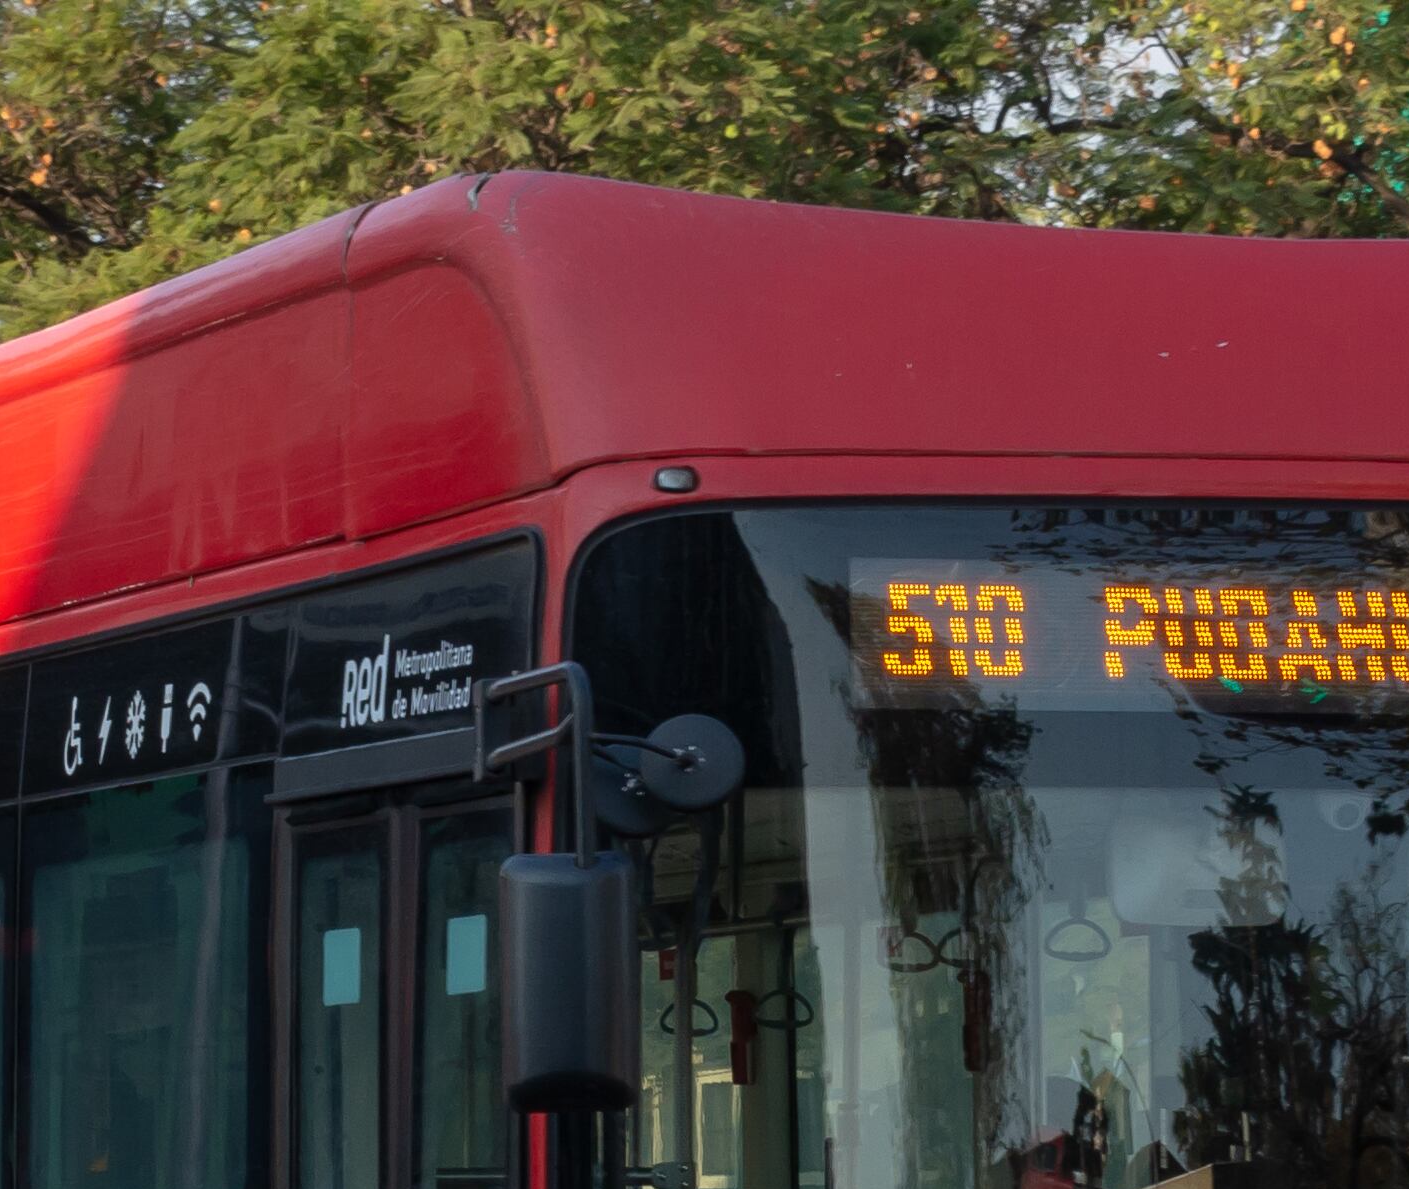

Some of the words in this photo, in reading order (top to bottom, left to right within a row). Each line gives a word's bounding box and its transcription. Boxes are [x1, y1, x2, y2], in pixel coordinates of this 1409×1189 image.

[394, 639, 473, 680] Metropolitana
[883, 583, 1026, 678] 510
[340, 633, 391, 728] Red
[391, 689, 408, 719] de
[410, 676, 472, 716] Movilidad
